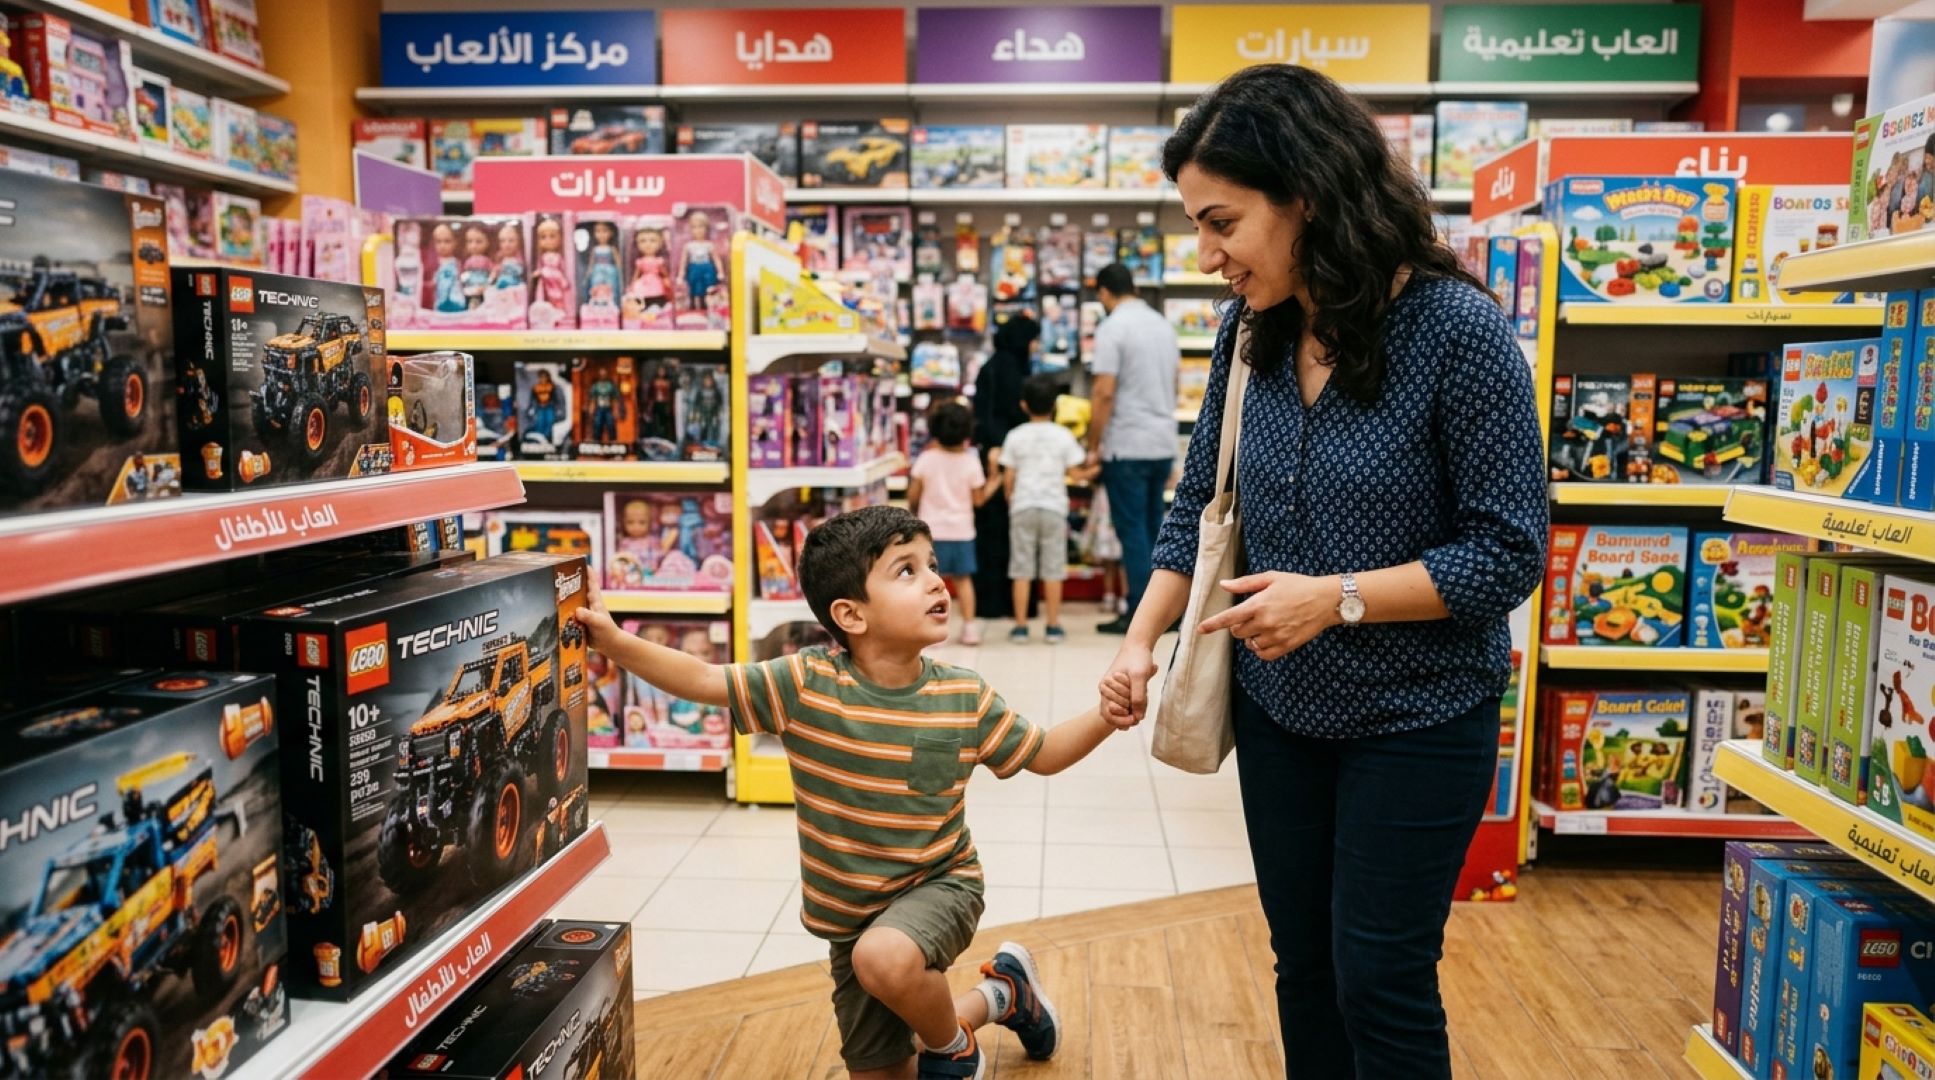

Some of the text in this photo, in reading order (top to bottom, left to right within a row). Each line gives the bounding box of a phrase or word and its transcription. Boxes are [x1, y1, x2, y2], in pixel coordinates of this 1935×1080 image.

[406, 25, 629, 73] مركز الألعاب
[735, 30, 833, 70] هدايا
[1236, 28, 1370, 65] سيارات
[1463, 25, 1678, 61] العاب تعليمية
[550, 168, 665, 204] سيارات
[1675, 146, 1748, 188] بناء
[214, 503, 339, 551] العاب للأطفال
[396, 609, 499, 660] TECHNIC
[306, 675, 324, 783] TECHNIC
[348, 703, 380, 730] 10+
[457, 931, 492, 979] العاب
